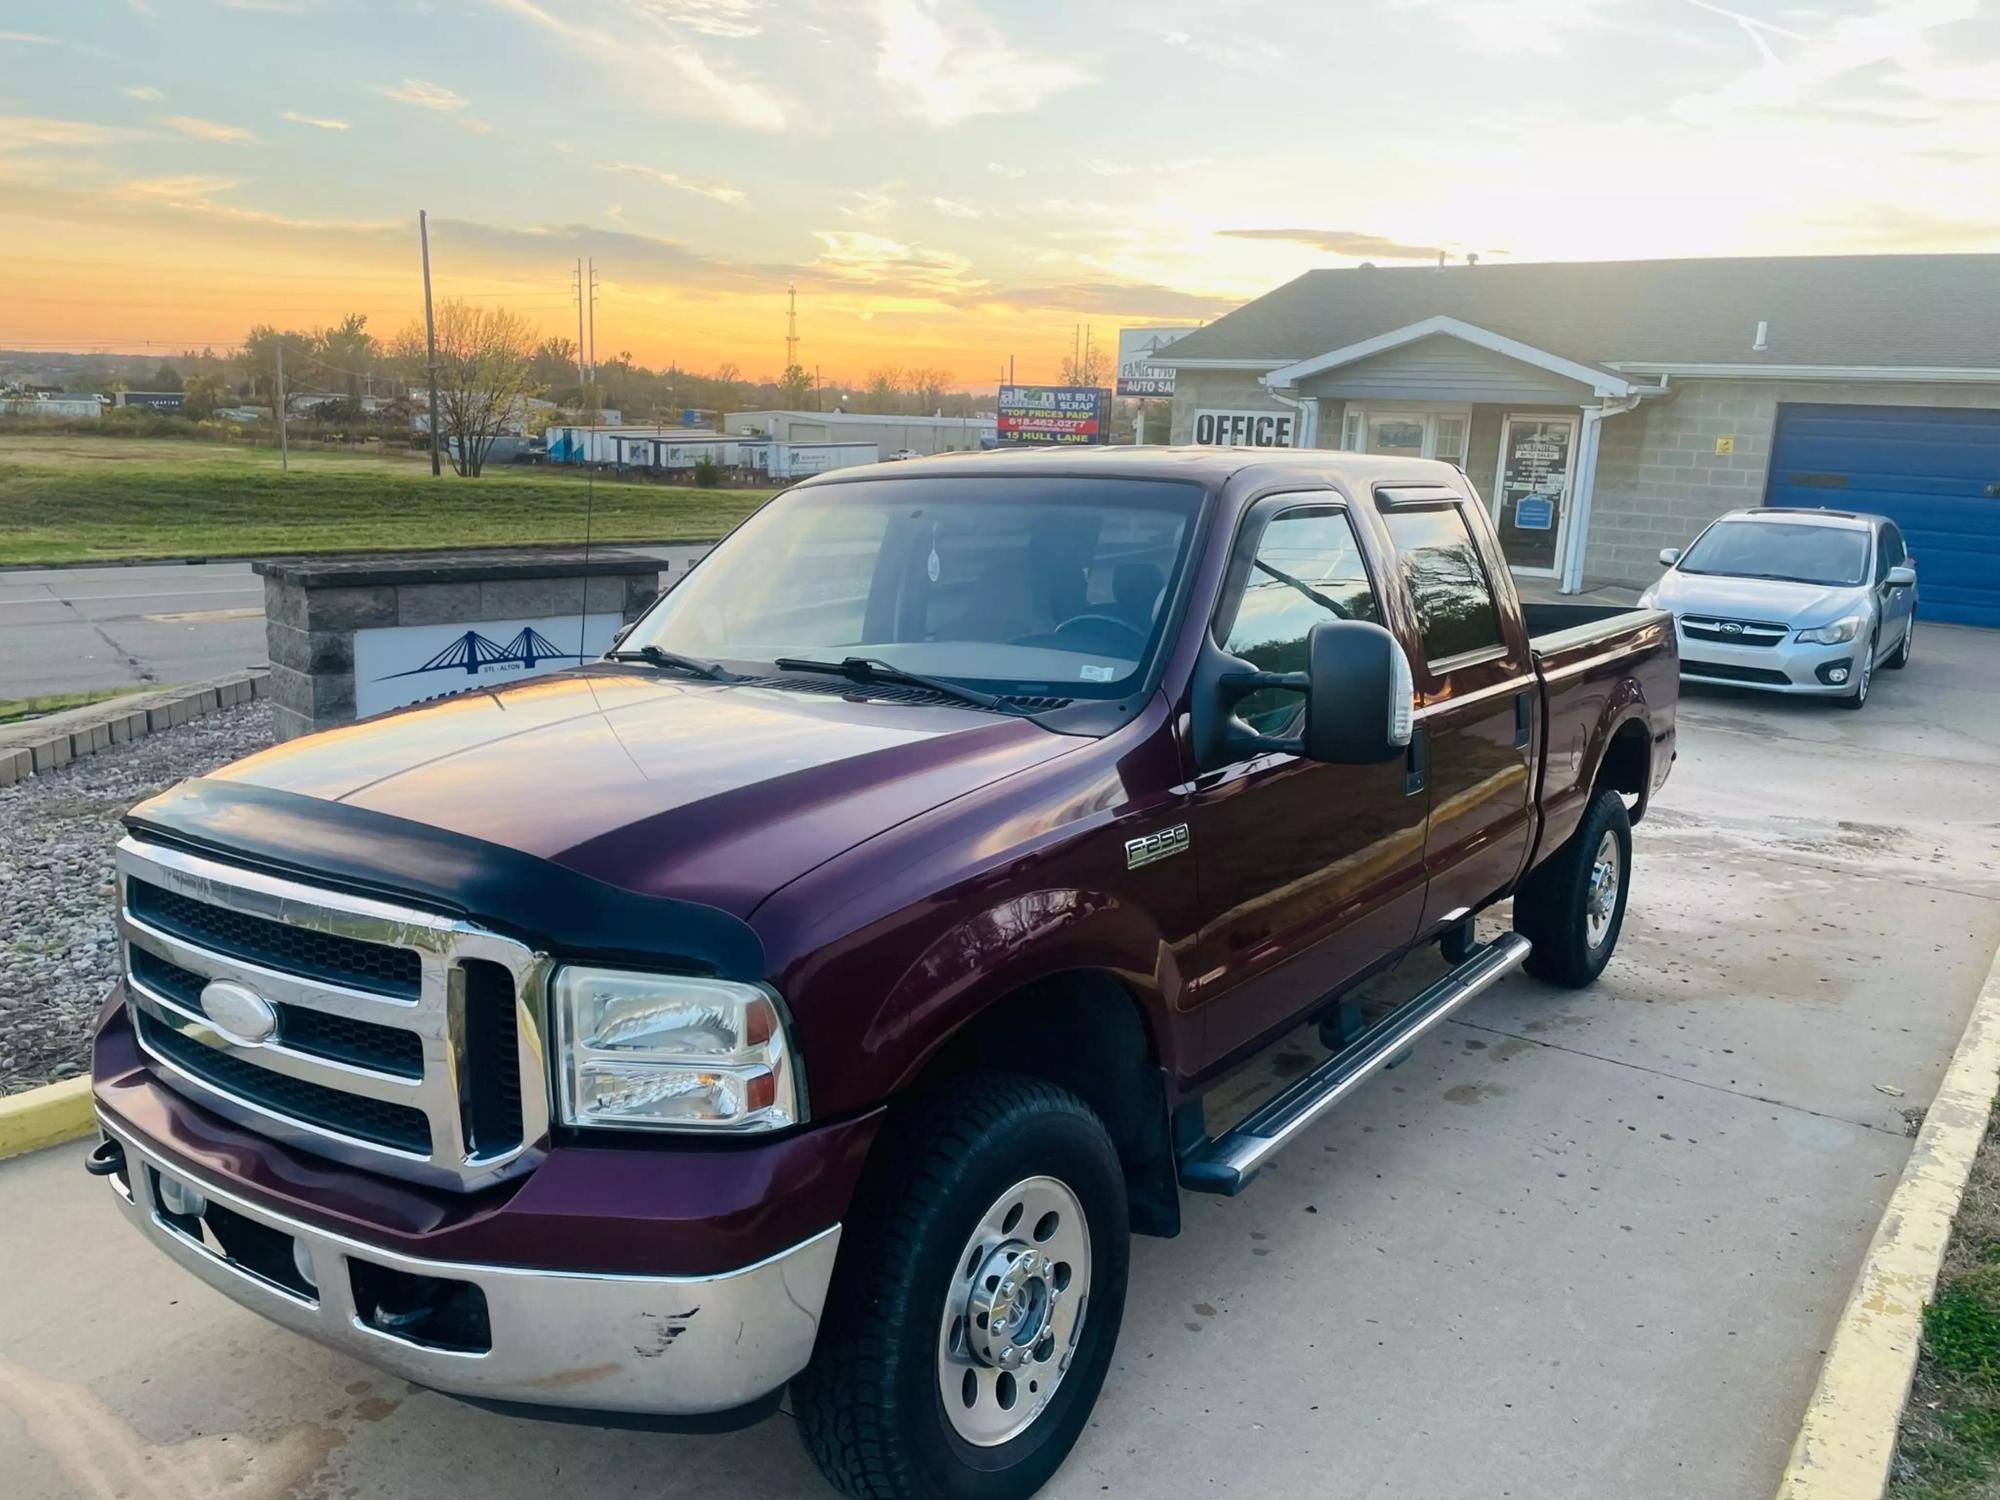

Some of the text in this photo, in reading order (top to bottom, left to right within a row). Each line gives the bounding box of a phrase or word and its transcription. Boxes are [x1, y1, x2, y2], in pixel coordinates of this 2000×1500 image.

[1127, 381, 1155, 392] AUTO
[1057, 393, 1097, 402] WE BUY
[1060, 402, 1093, 410] SCRAP
[1029, 410, 1064, 418] PRICES
[1197, 415, 1291, 447] OFFICE
[1023, 432, 1054, 440] HULL
[1057, 434, 1089, 442] LANE
